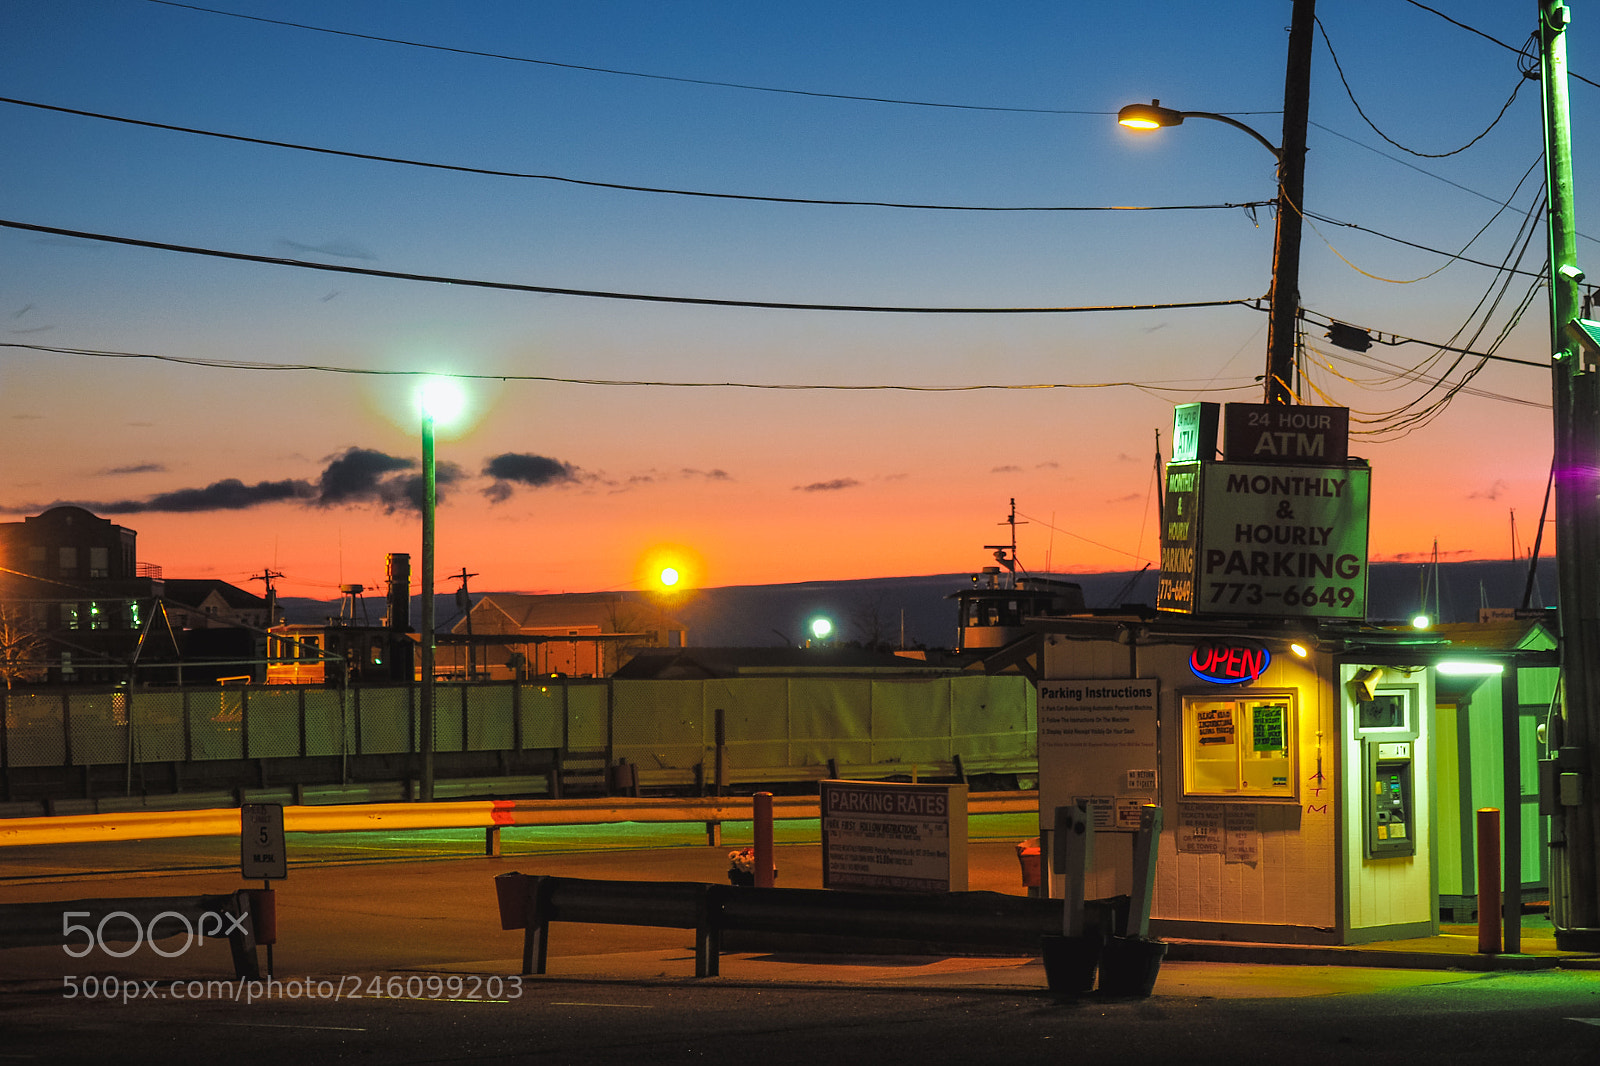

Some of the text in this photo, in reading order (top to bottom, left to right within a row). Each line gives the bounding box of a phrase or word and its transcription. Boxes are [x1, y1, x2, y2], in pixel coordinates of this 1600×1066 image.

[1248, 412, 1331, 430] 24 HOUR
[1178, 430, 1195, 454] ATM
[1253, 432, 1325, 457] ATM
[1169, 473, 1195, 493] MONTHLY
[1227, 474, 1347, 498] MONTHLY
[1178, 497, 1183, 516] &
[1276, 501, 1295, 519] &
[1168, 522, 1190, 541] HOURLY
[1236, 524, 1334, 546] HOURLY
[1161, 548, 1193, 573] PARKING
[1207, 550, 1361, 580] PARKING
[1160, 579, 1191, 602] 773-6649
[1210, 583, 1355, 608] 773-6649
[1191, 648, 1262, 681] OPEN
[1042, 687, 1152, 701] Parking Instructions
[831, 792, 945, 815] PARKING RATES
[260, 827, 268, 843] 5
